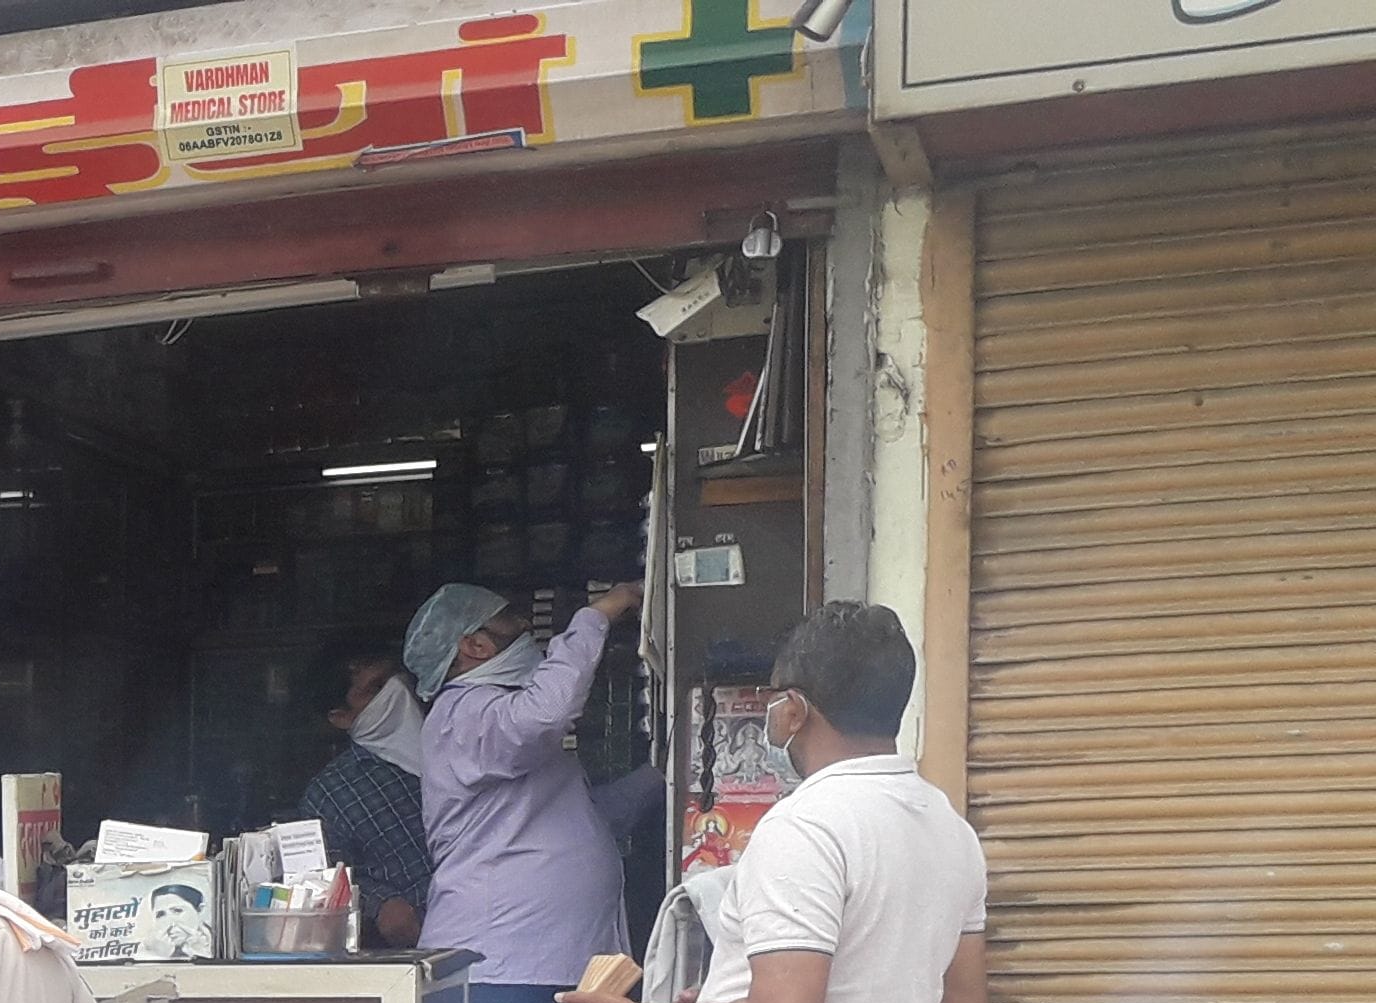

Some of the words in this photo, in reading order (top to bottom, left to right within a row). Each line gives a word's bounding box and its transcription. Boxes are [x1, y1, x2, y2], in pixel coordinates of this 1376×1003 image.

[183, 61, 270, 93] VARDHMAN
[169, 97, 234, 124] MEDICAL
[238, 90, 286, 116] STORE
[89, 924, 108, 940] को
